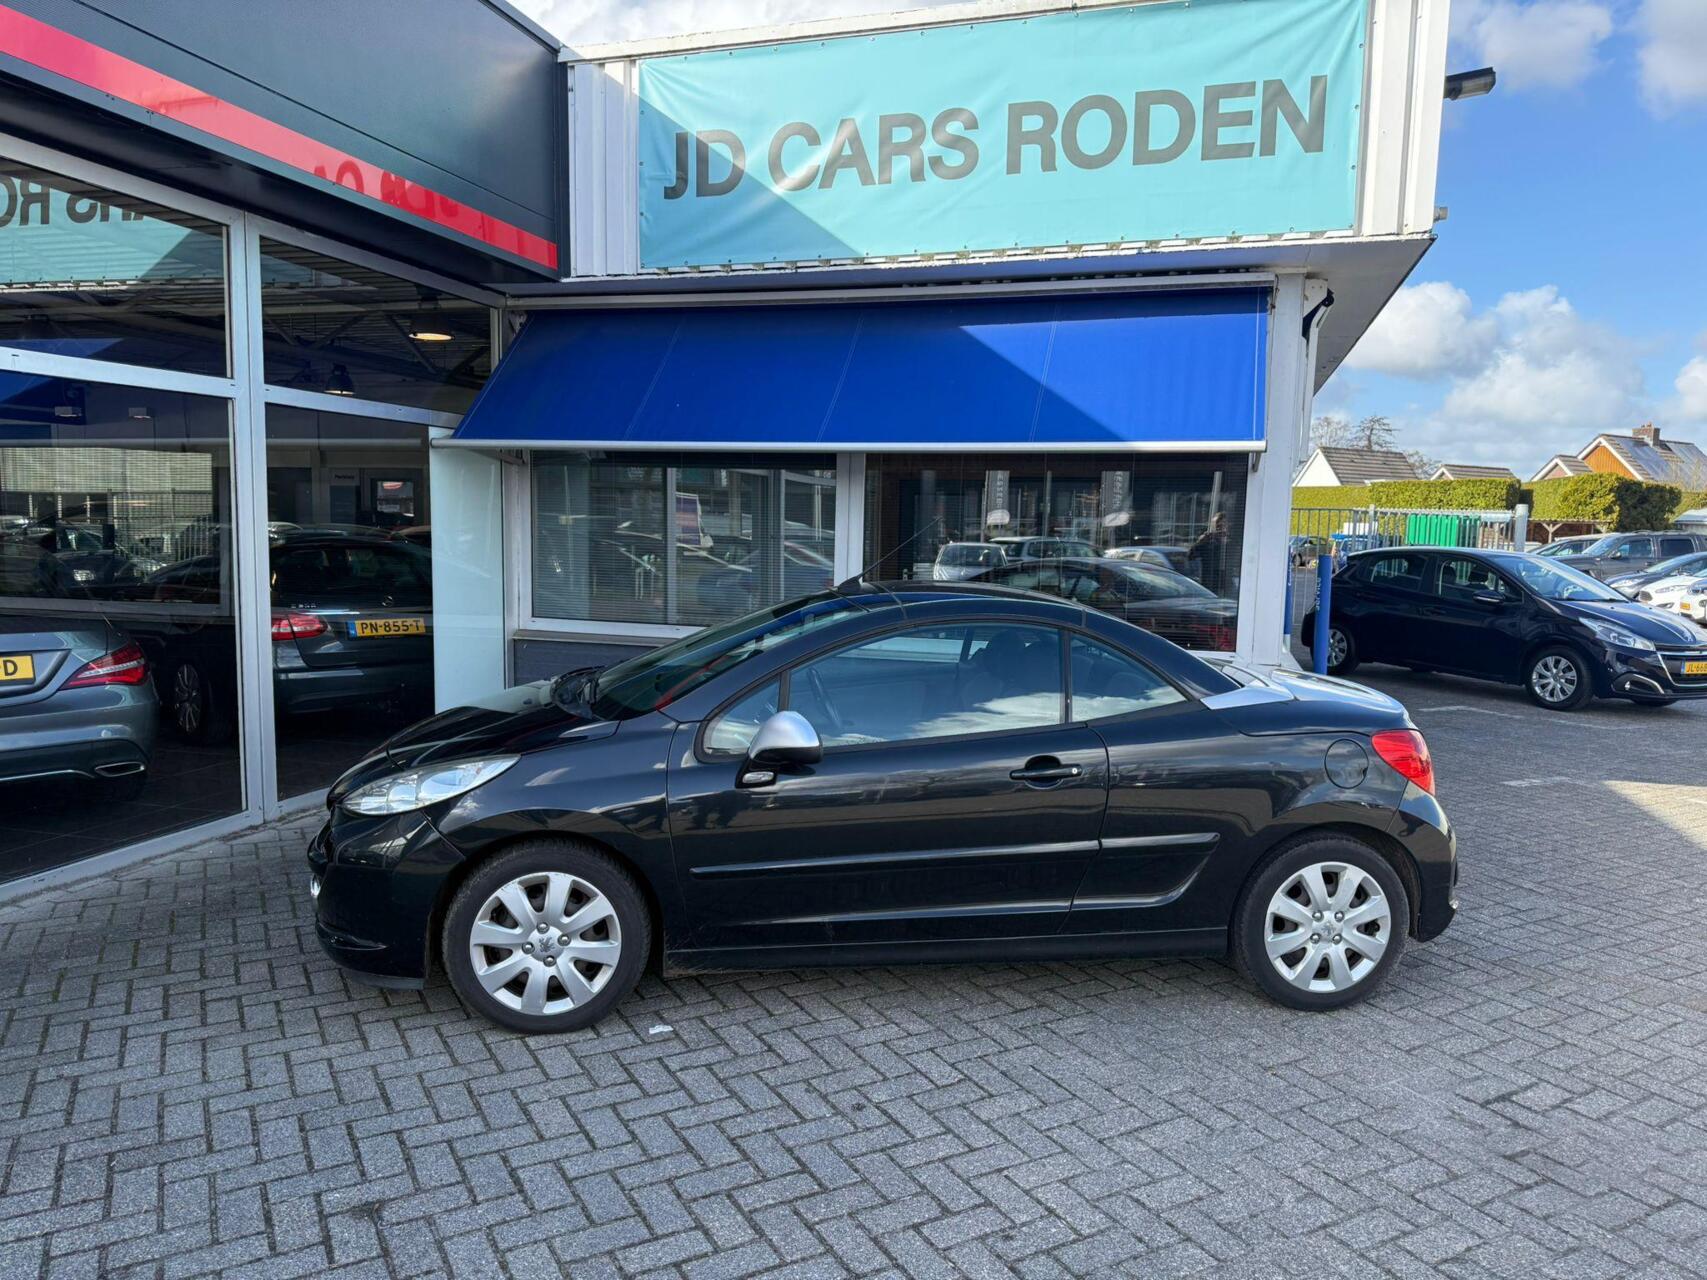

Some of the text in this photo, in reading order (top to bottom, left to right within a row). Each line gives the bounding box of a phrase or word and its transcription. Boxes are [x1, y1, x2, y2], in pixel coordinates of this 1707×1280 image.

[663, 74, 1328, 200] JD CARS RODEN
[361, 620, 420, 634] PN-855-T
